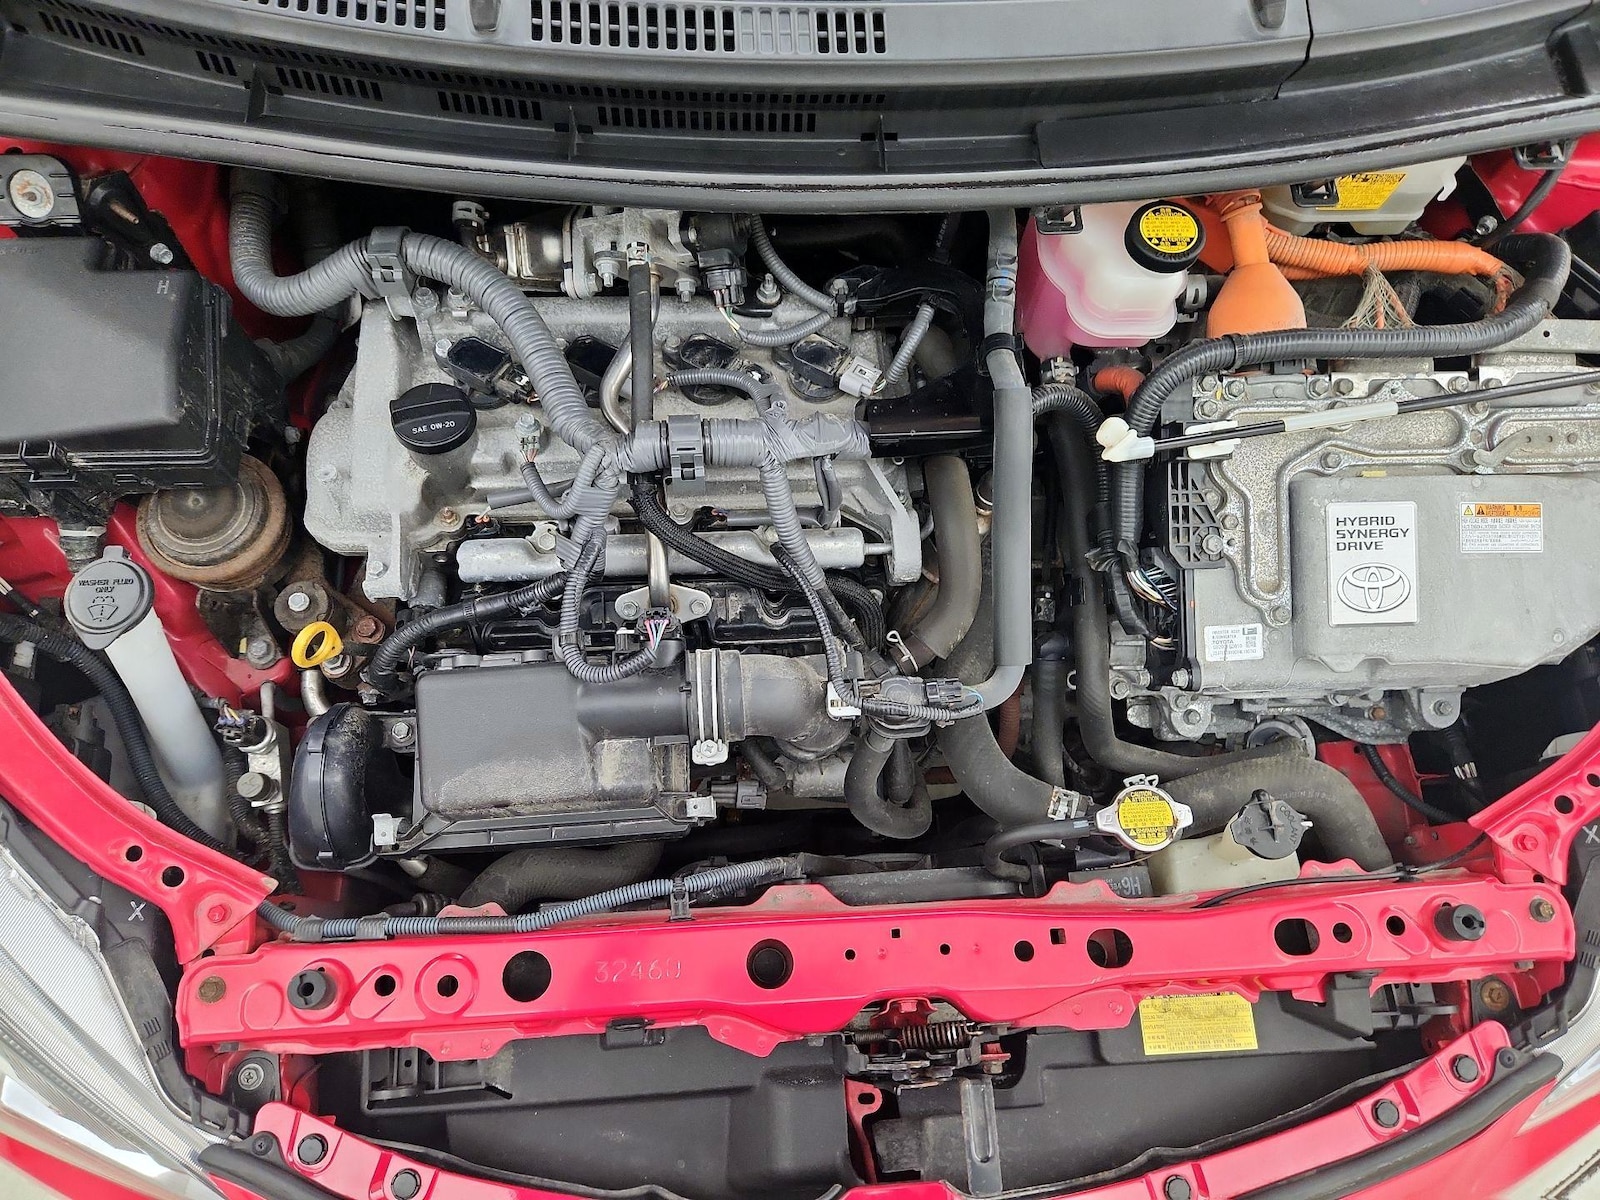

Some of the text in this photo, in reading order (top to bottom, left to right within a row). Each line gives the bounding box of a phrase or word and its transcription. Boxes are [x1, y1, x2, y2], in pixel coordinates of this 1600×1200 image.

[412, 421, 455, 434] SAE 0W-20
[1336, 516, 1395, 526] HYBRID
[1336, 528, 1410, 539] SYNERGY
[1336, 541, 1384, 551] DRIVE
[1280, 805, 1298, 844] COOLANT
